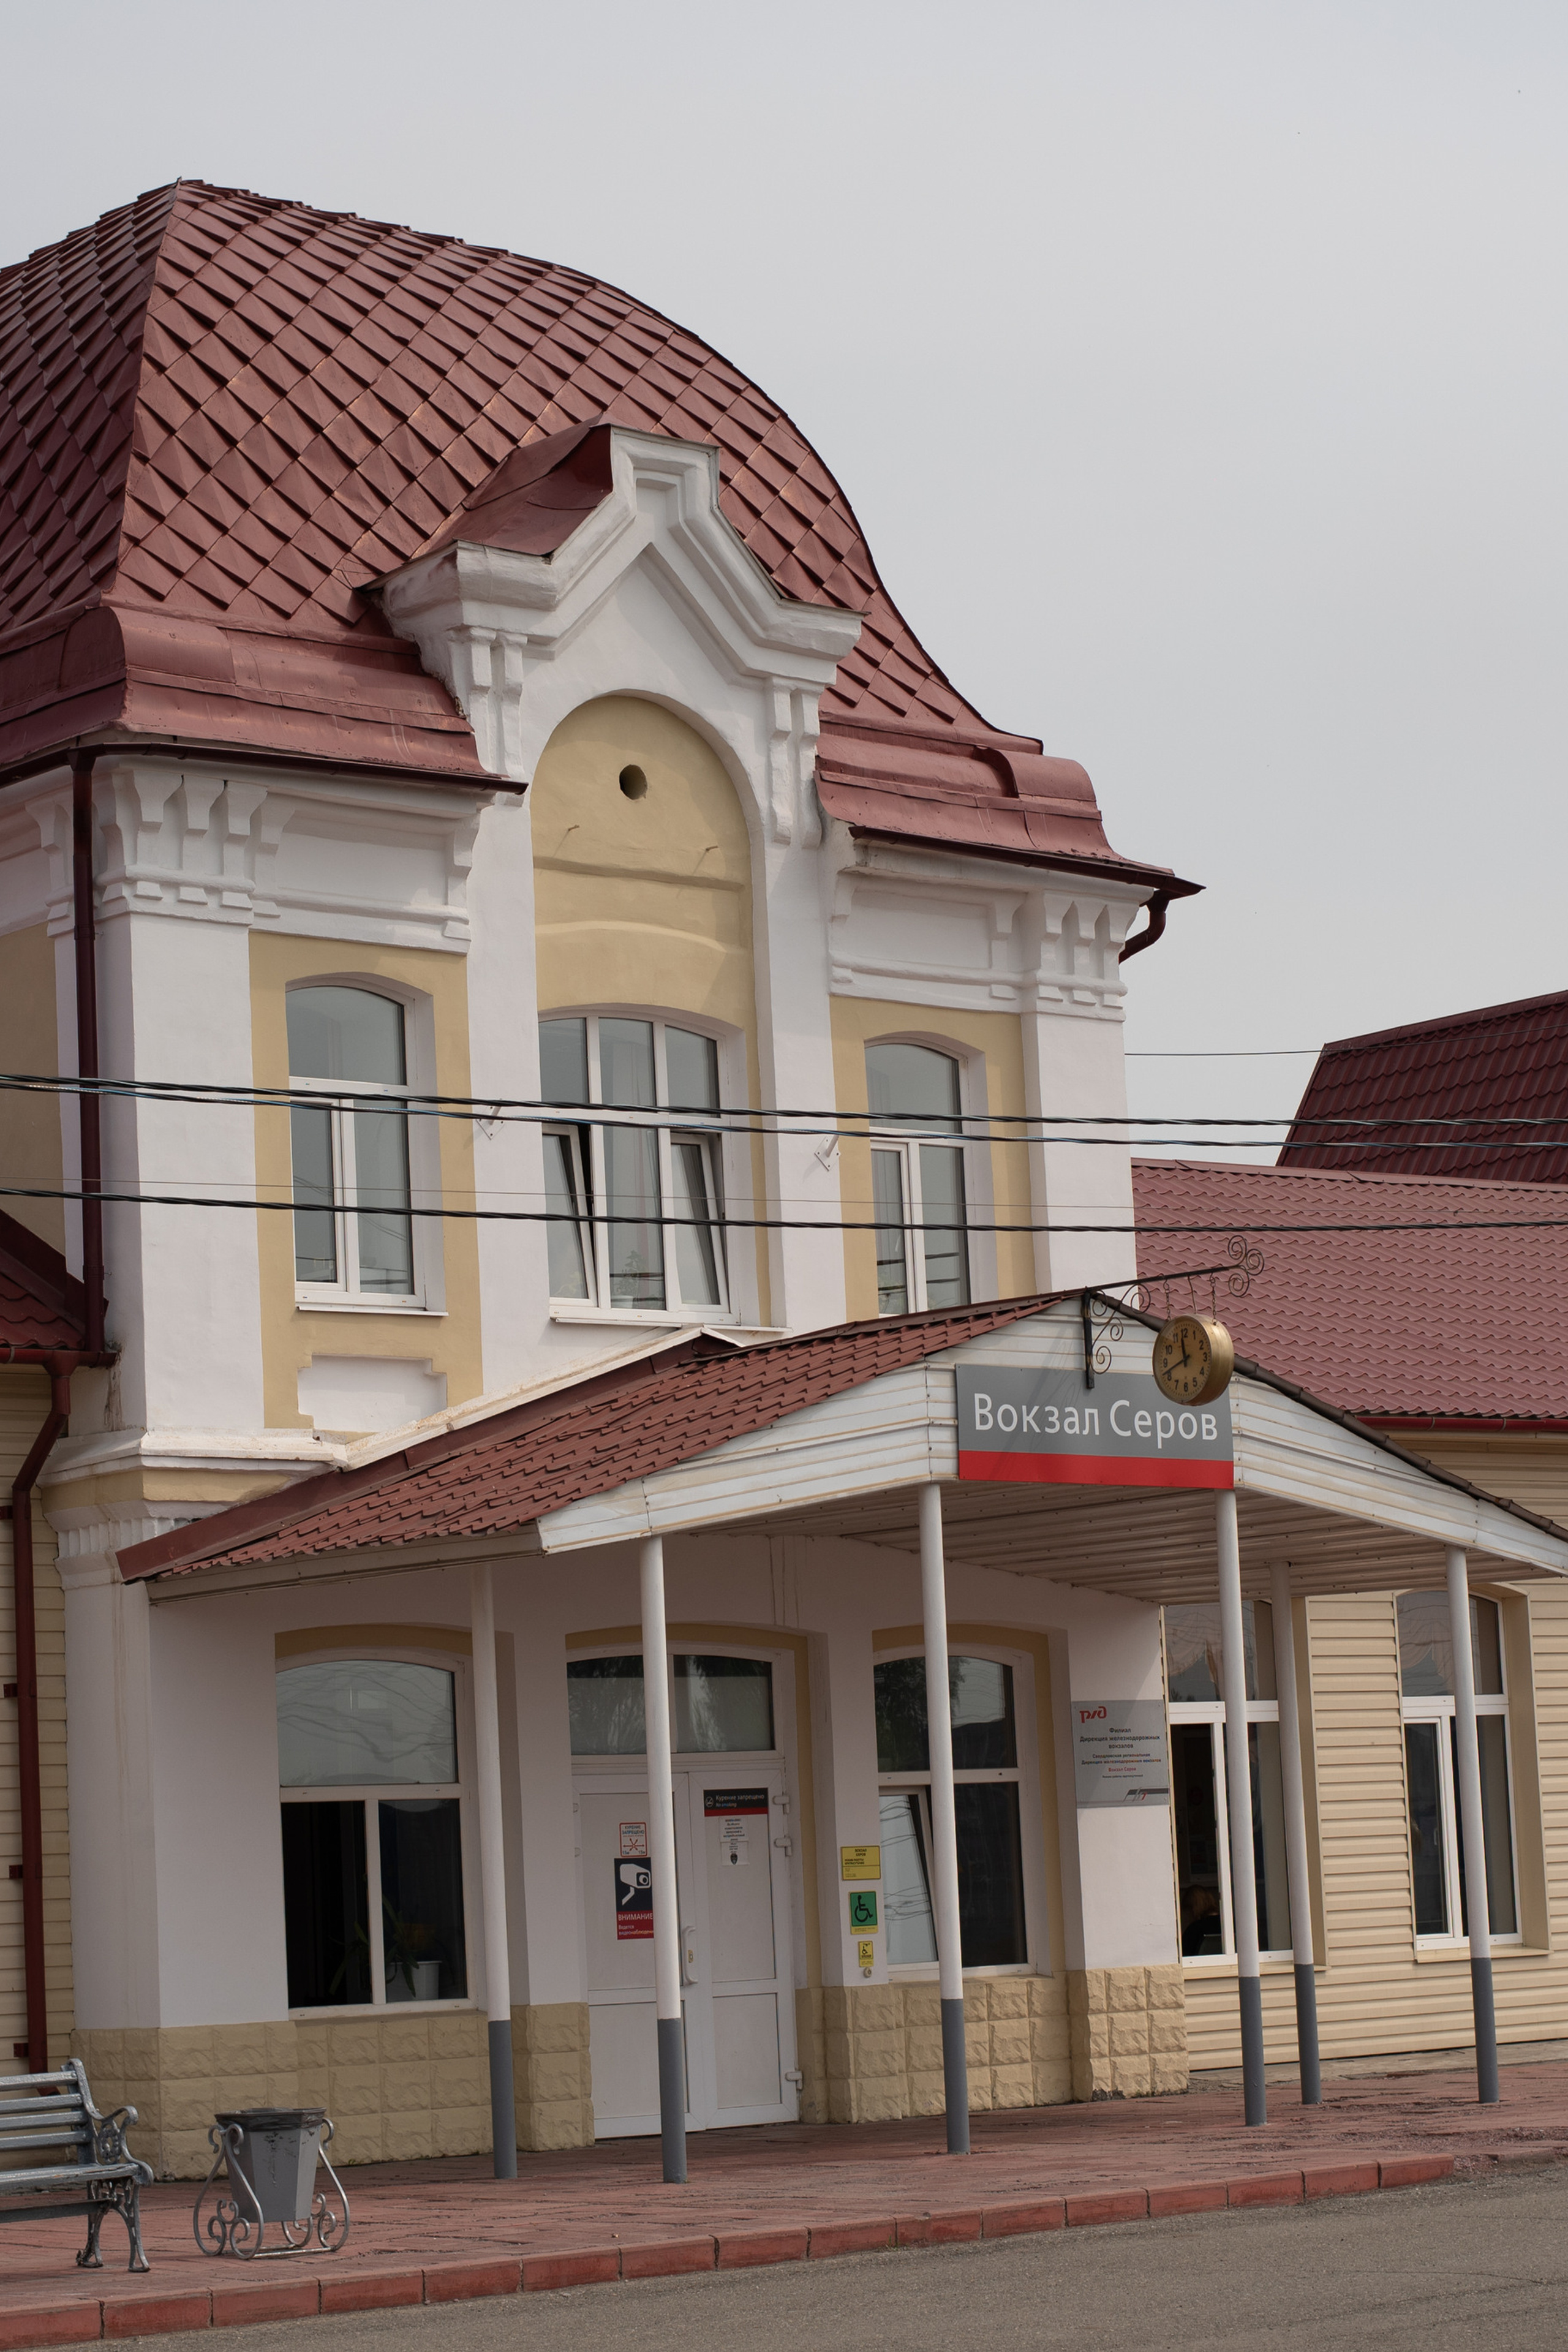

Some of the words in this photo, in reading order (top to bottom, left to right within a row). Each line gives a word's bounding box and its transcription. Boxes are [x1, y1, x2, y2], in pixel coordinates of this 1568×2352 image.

[1173, 1333, 1178, 1343] 11
[1193, 1330, 1196, 1340] 1
[1166, 1345, 1172, 1355] 10
[1199, 1340, 1204, 1350] 2
[1203, 1352, 1208, 1362] 3
[1163, 1358, 1168, 1368] 9
[1167, 1369, 1172, 1381] 8
[1199, 1366, 1205, 1376] 4
[1174, 1379, 1179, 1390] 7
[1183, 1382, 1188, 1392] 6
[1193, 1377, 1197, 1387] 5
[974, 1393, 1100, 1436] Вокзал
[1109, 1400, 1218, 1449] Серов
